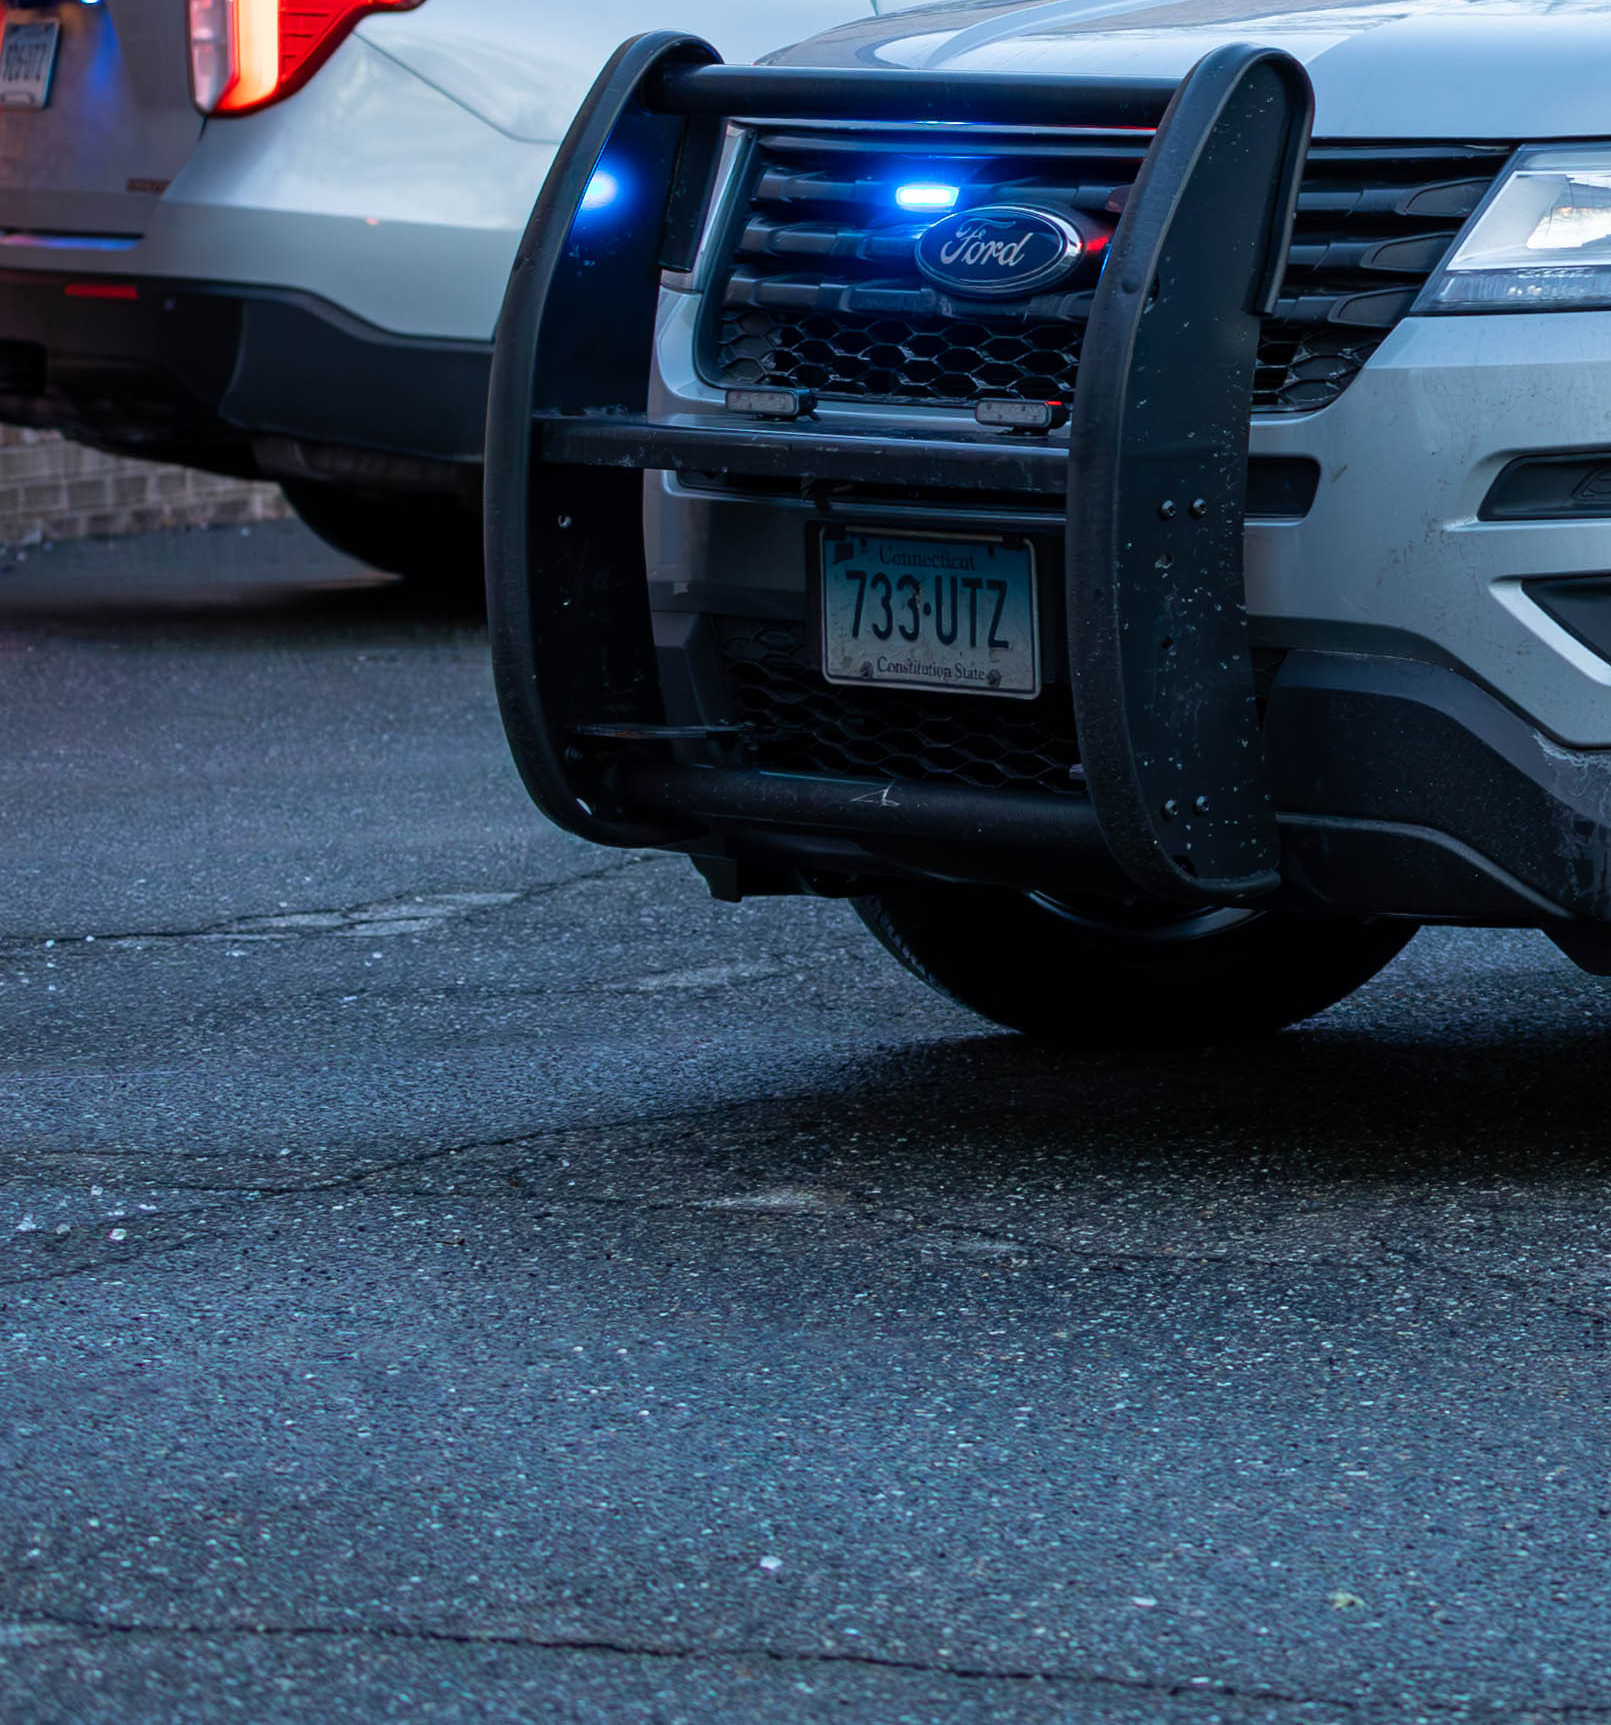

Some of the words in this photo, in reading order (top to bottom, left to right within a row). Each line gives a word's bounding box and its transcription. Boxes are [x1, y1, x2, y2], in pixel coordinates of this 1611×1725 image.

[940, 218, 1035, 267] Ford
[879, 544, 976, 572] Connecticut
[876, 656, 951, 679] Constitution
[954, 661, 987, 682] State
